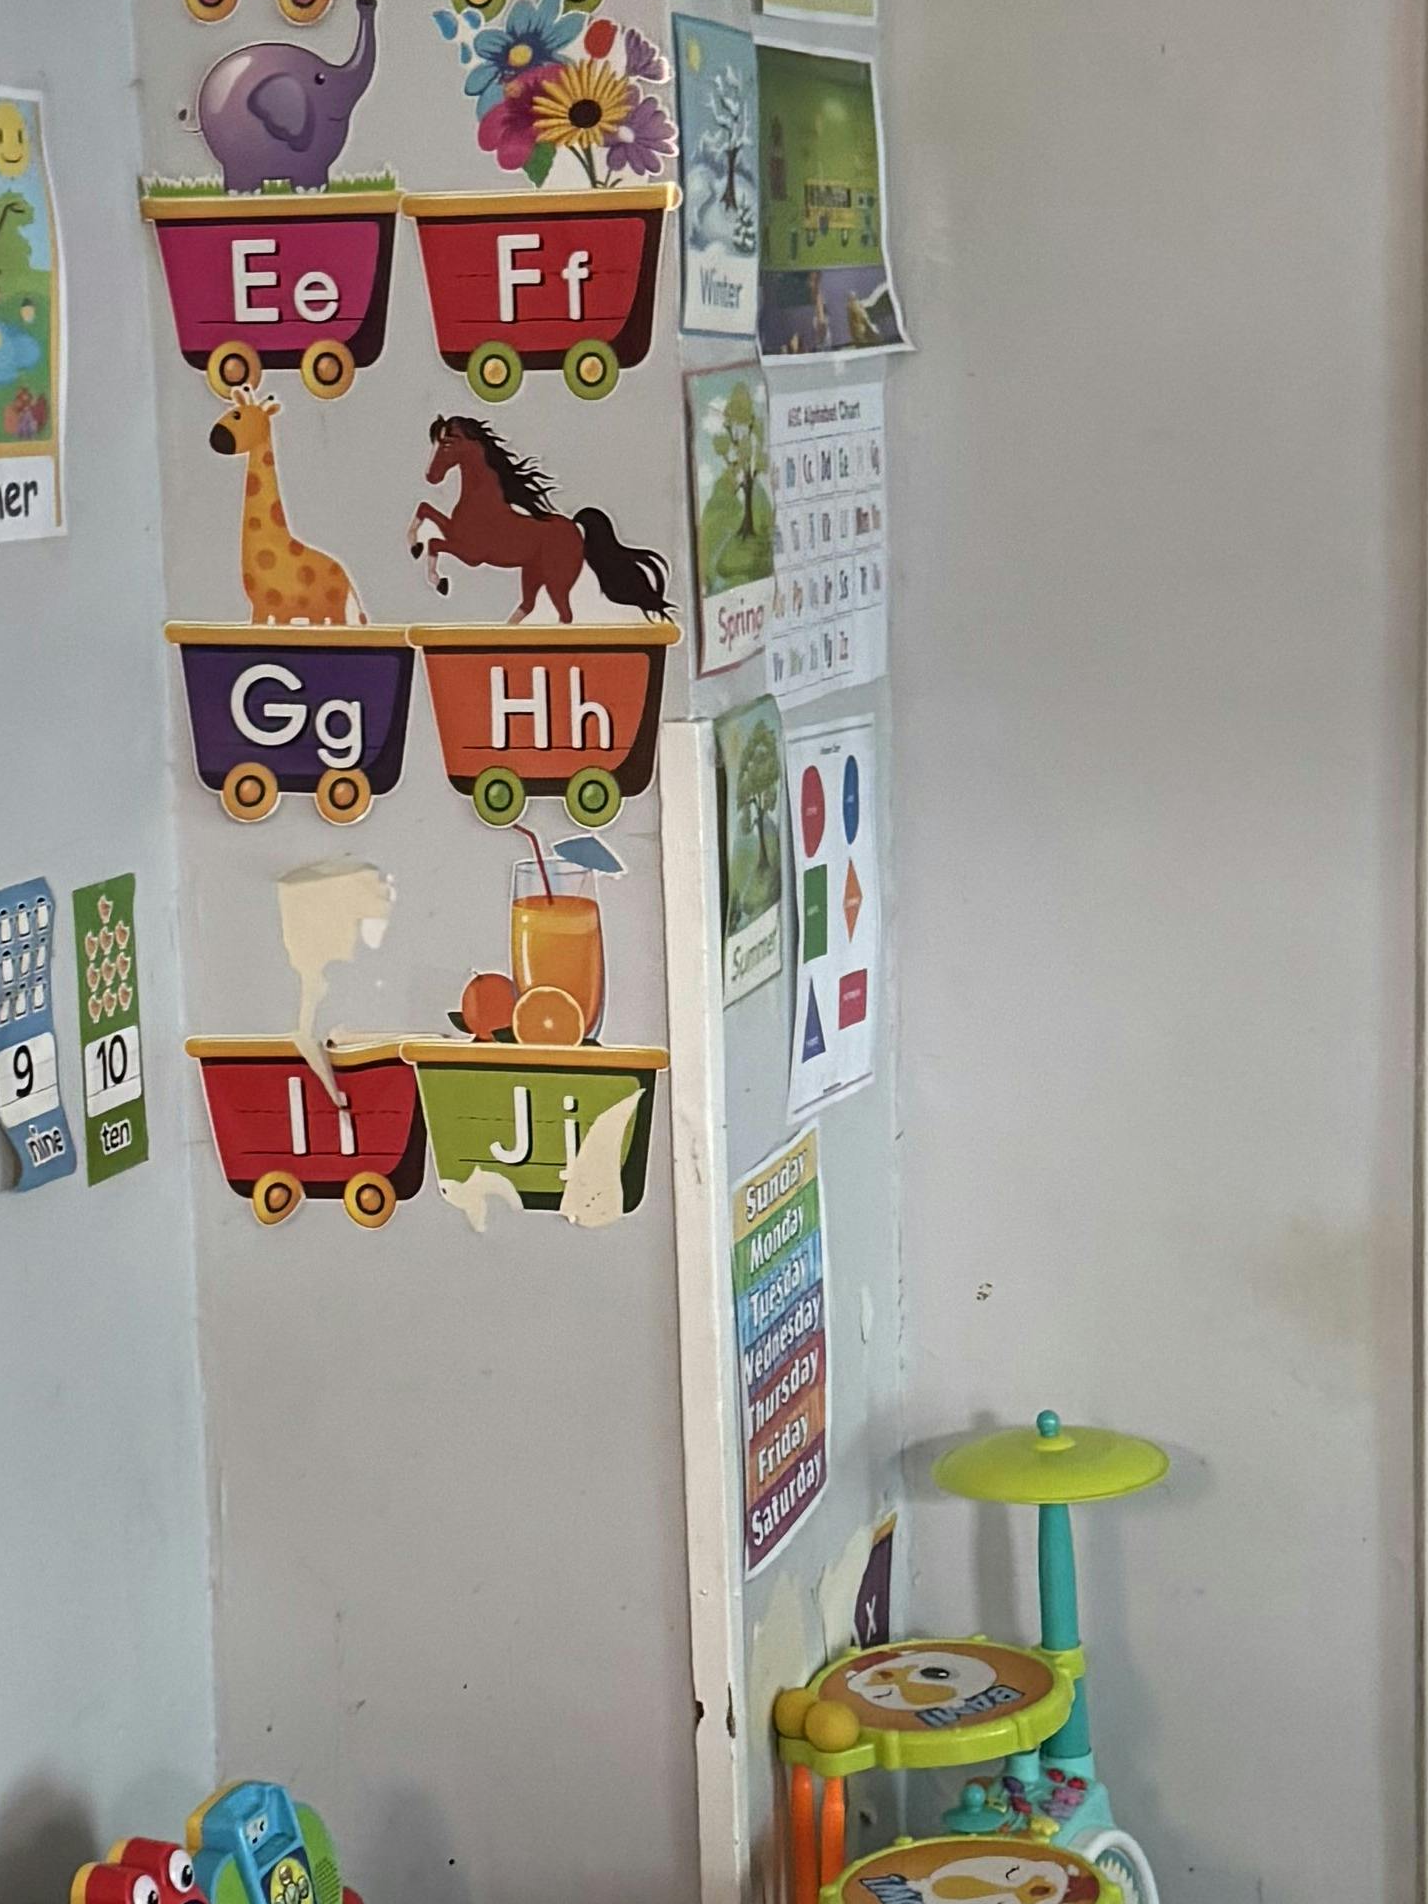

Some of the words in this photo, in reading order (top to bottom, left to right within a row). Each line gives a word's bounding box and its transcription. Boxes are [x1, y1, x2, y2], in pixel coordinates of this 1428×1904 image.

[231, 238, 339, 324] Ee
[496, 232, 589, 323] Ff
[700, 266, 744, 310] Winter
[718, 598, 764, 651] Spring
[229, 662, 363, 769] Gg
[489, 664, 612, 751] Hh
[731, 929, 778, 982] Summer
[12, 1045, 34, 1098] 9
[95, 1033, 128, 1090] 10
[27, 1124, 62, 1165] nine
[102, 1120, 130, 1152] ten
[745, 1147, 807, 1222] Sunday
[749, 1201, 805, 1273] Monday
[749, 1253, 808, 1328] Tuesday
[743, 1294, 821, 1386] Wednesday
[747, 1345, 820, 1440] Thursday
[757, 1411, 810, 1484] Friday
[751, 1447, 823, 1546] Saturday
